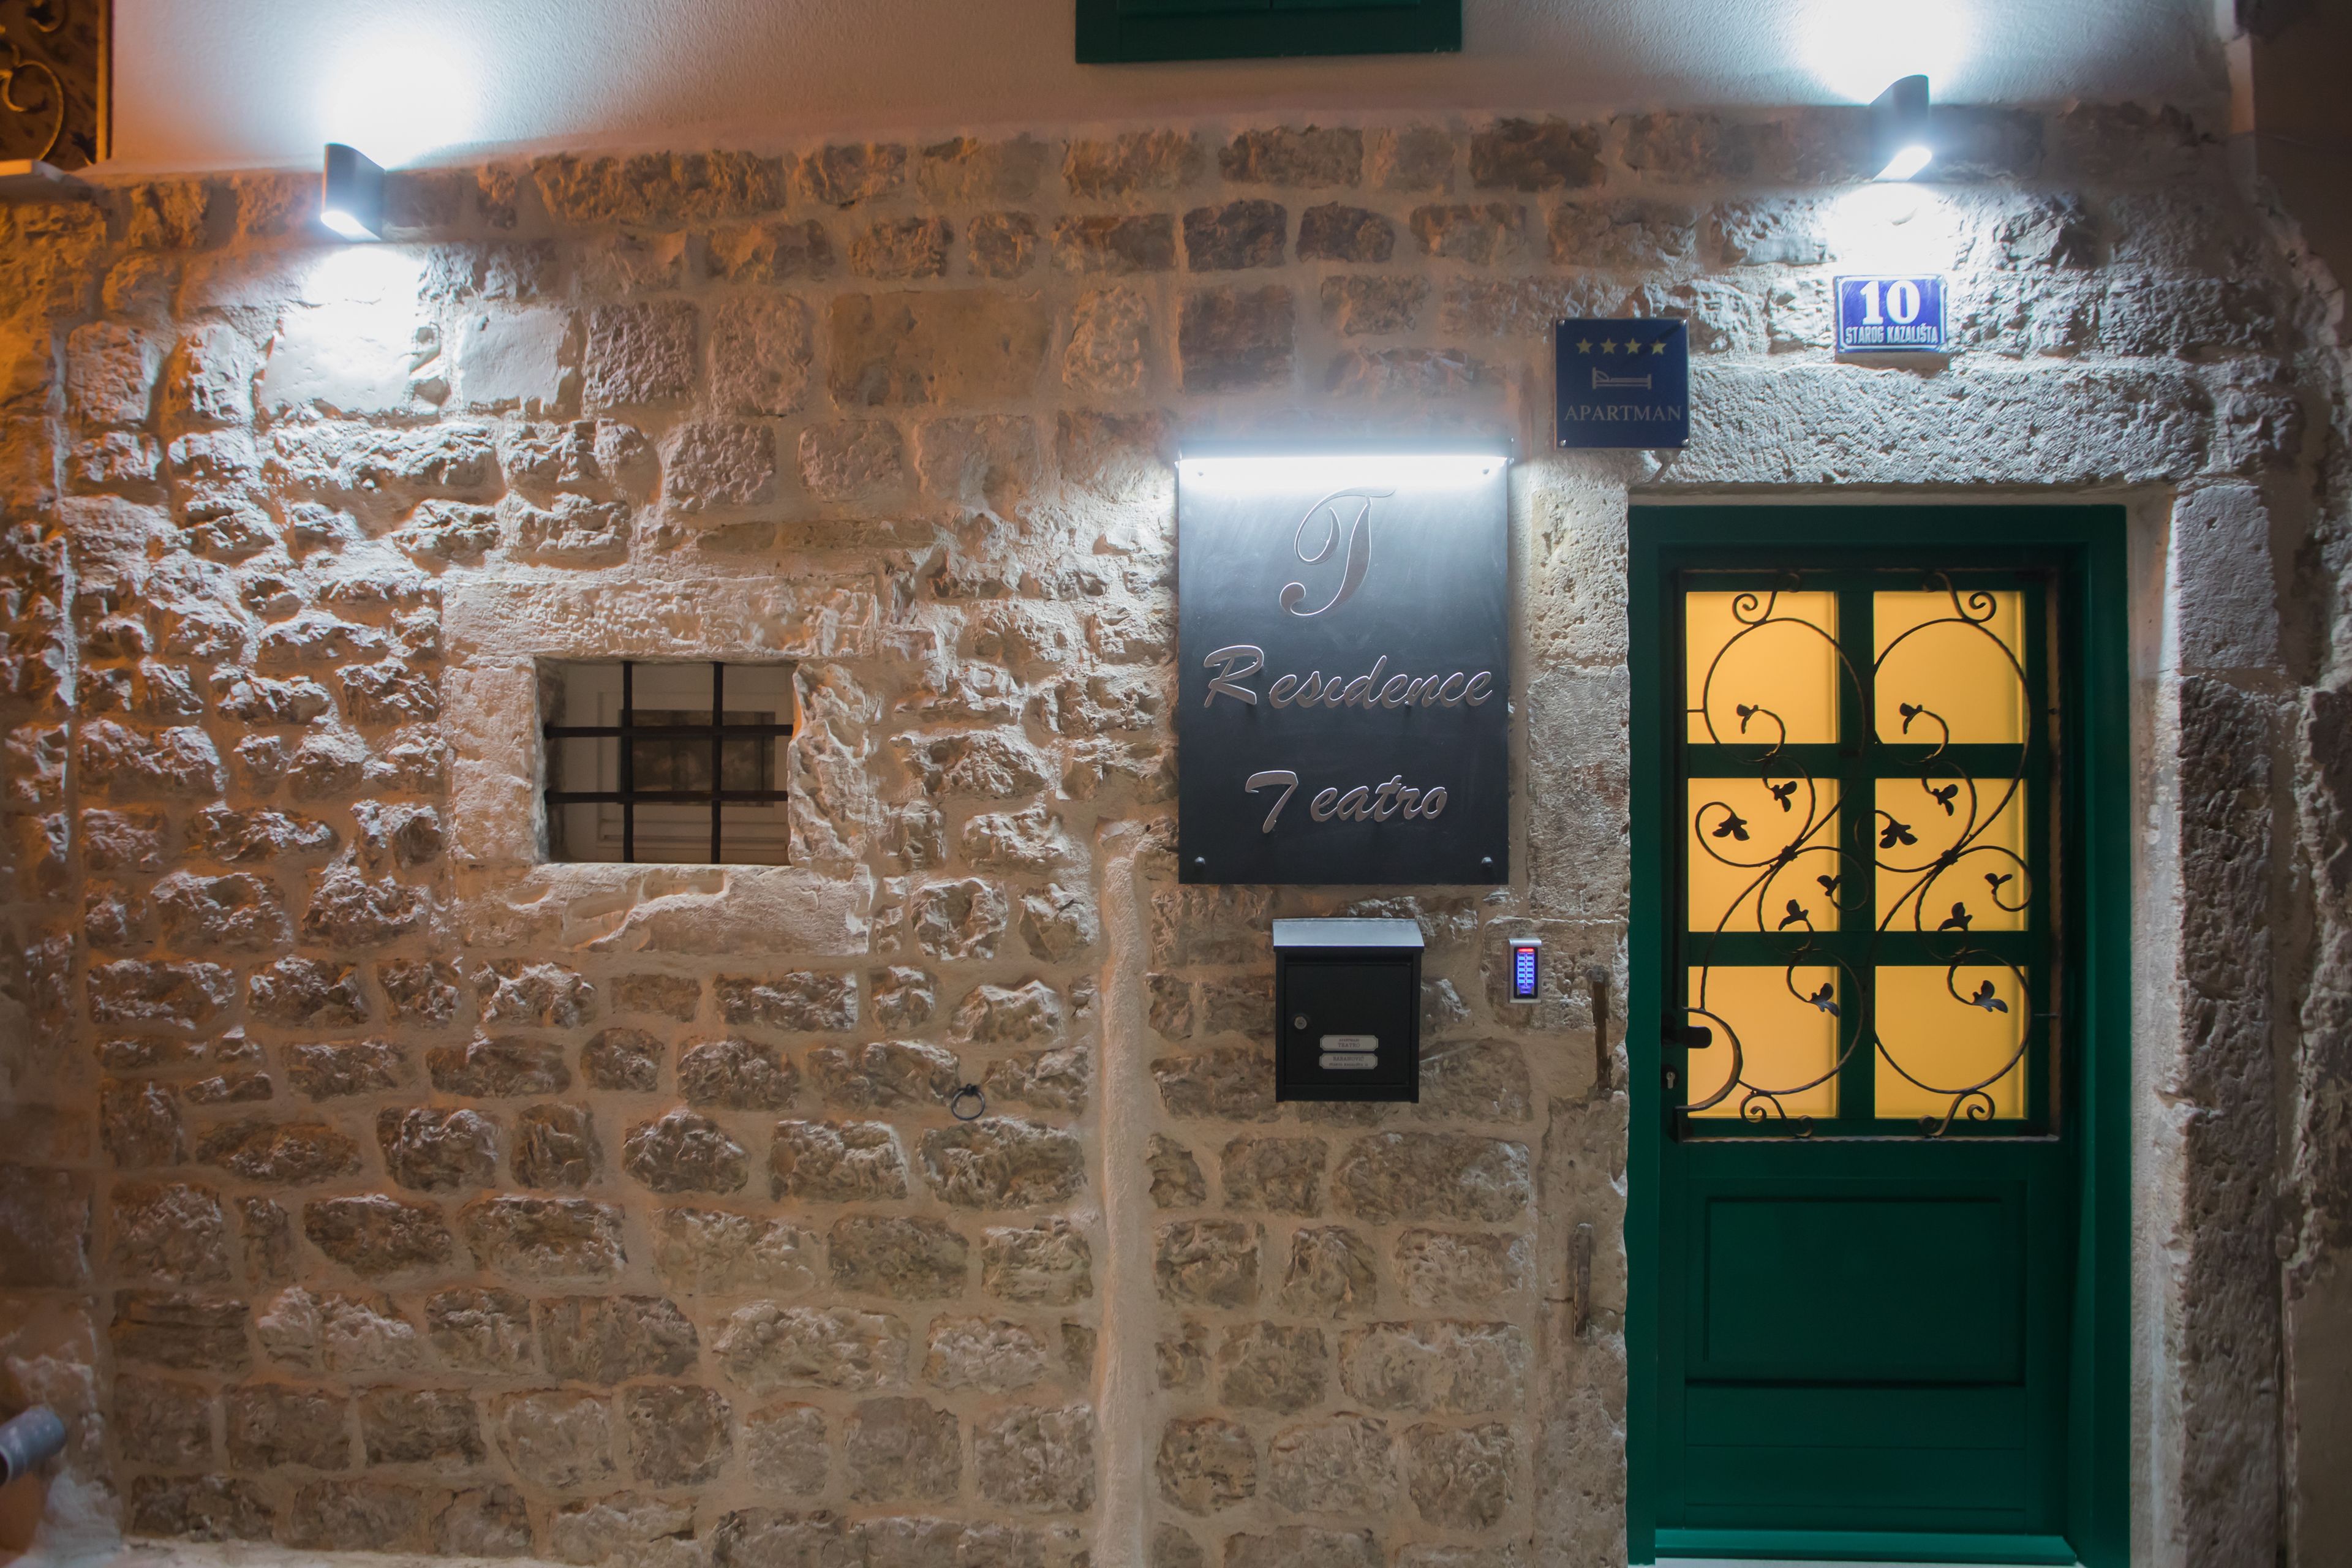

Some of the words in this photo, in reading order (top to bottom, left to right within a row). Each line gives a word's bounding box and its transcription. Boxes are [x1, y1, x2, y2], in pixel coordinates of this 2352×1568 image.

[1860, 280, 1920, 325] 10
[1845, 326, 1885, 344] STAROG
[1887, 323, 1939, 344] KAZALIŠTA
[1564, 405, 1682, 421] APARTMAN
[1203, 645, 1494, 709] Residence
[1245, 770, 1449, 834] Teatro
